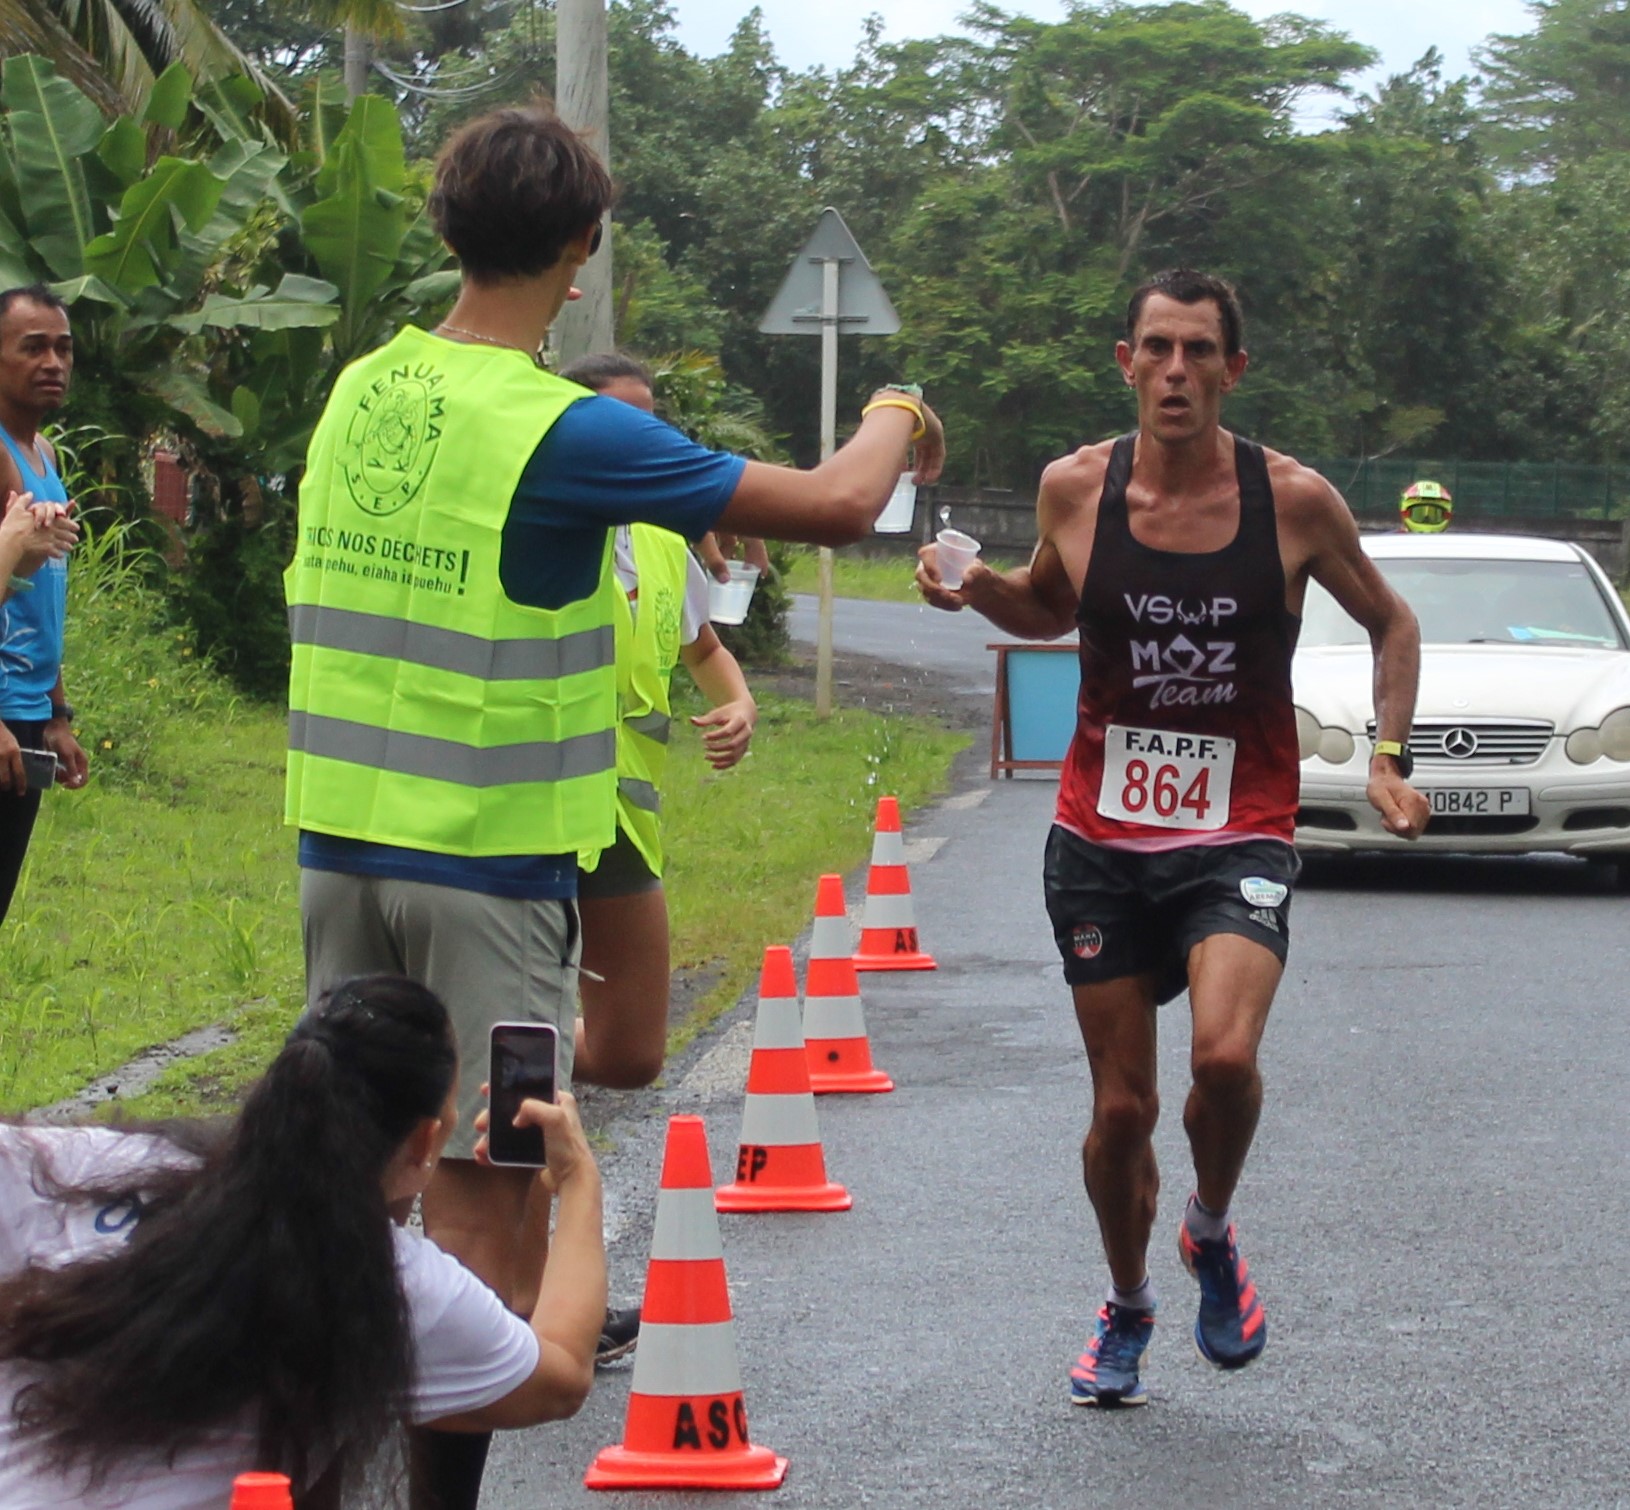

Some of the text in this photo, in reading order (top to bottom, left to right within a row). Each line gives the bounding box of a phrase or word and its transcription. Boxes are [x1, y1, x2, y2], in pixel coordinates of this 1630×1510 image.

[338, 530, 376, 555] NOS
[362, 563, 398, 582] eiaha
[1133, 674, 1238, 710] Team
[1125, 731, 1218, 760] F.A.P.F.
[1121, 759, 1211, 820] 864
[1500, 791, 1512, 812] P
[736, 1146, 767, 1183] EP
